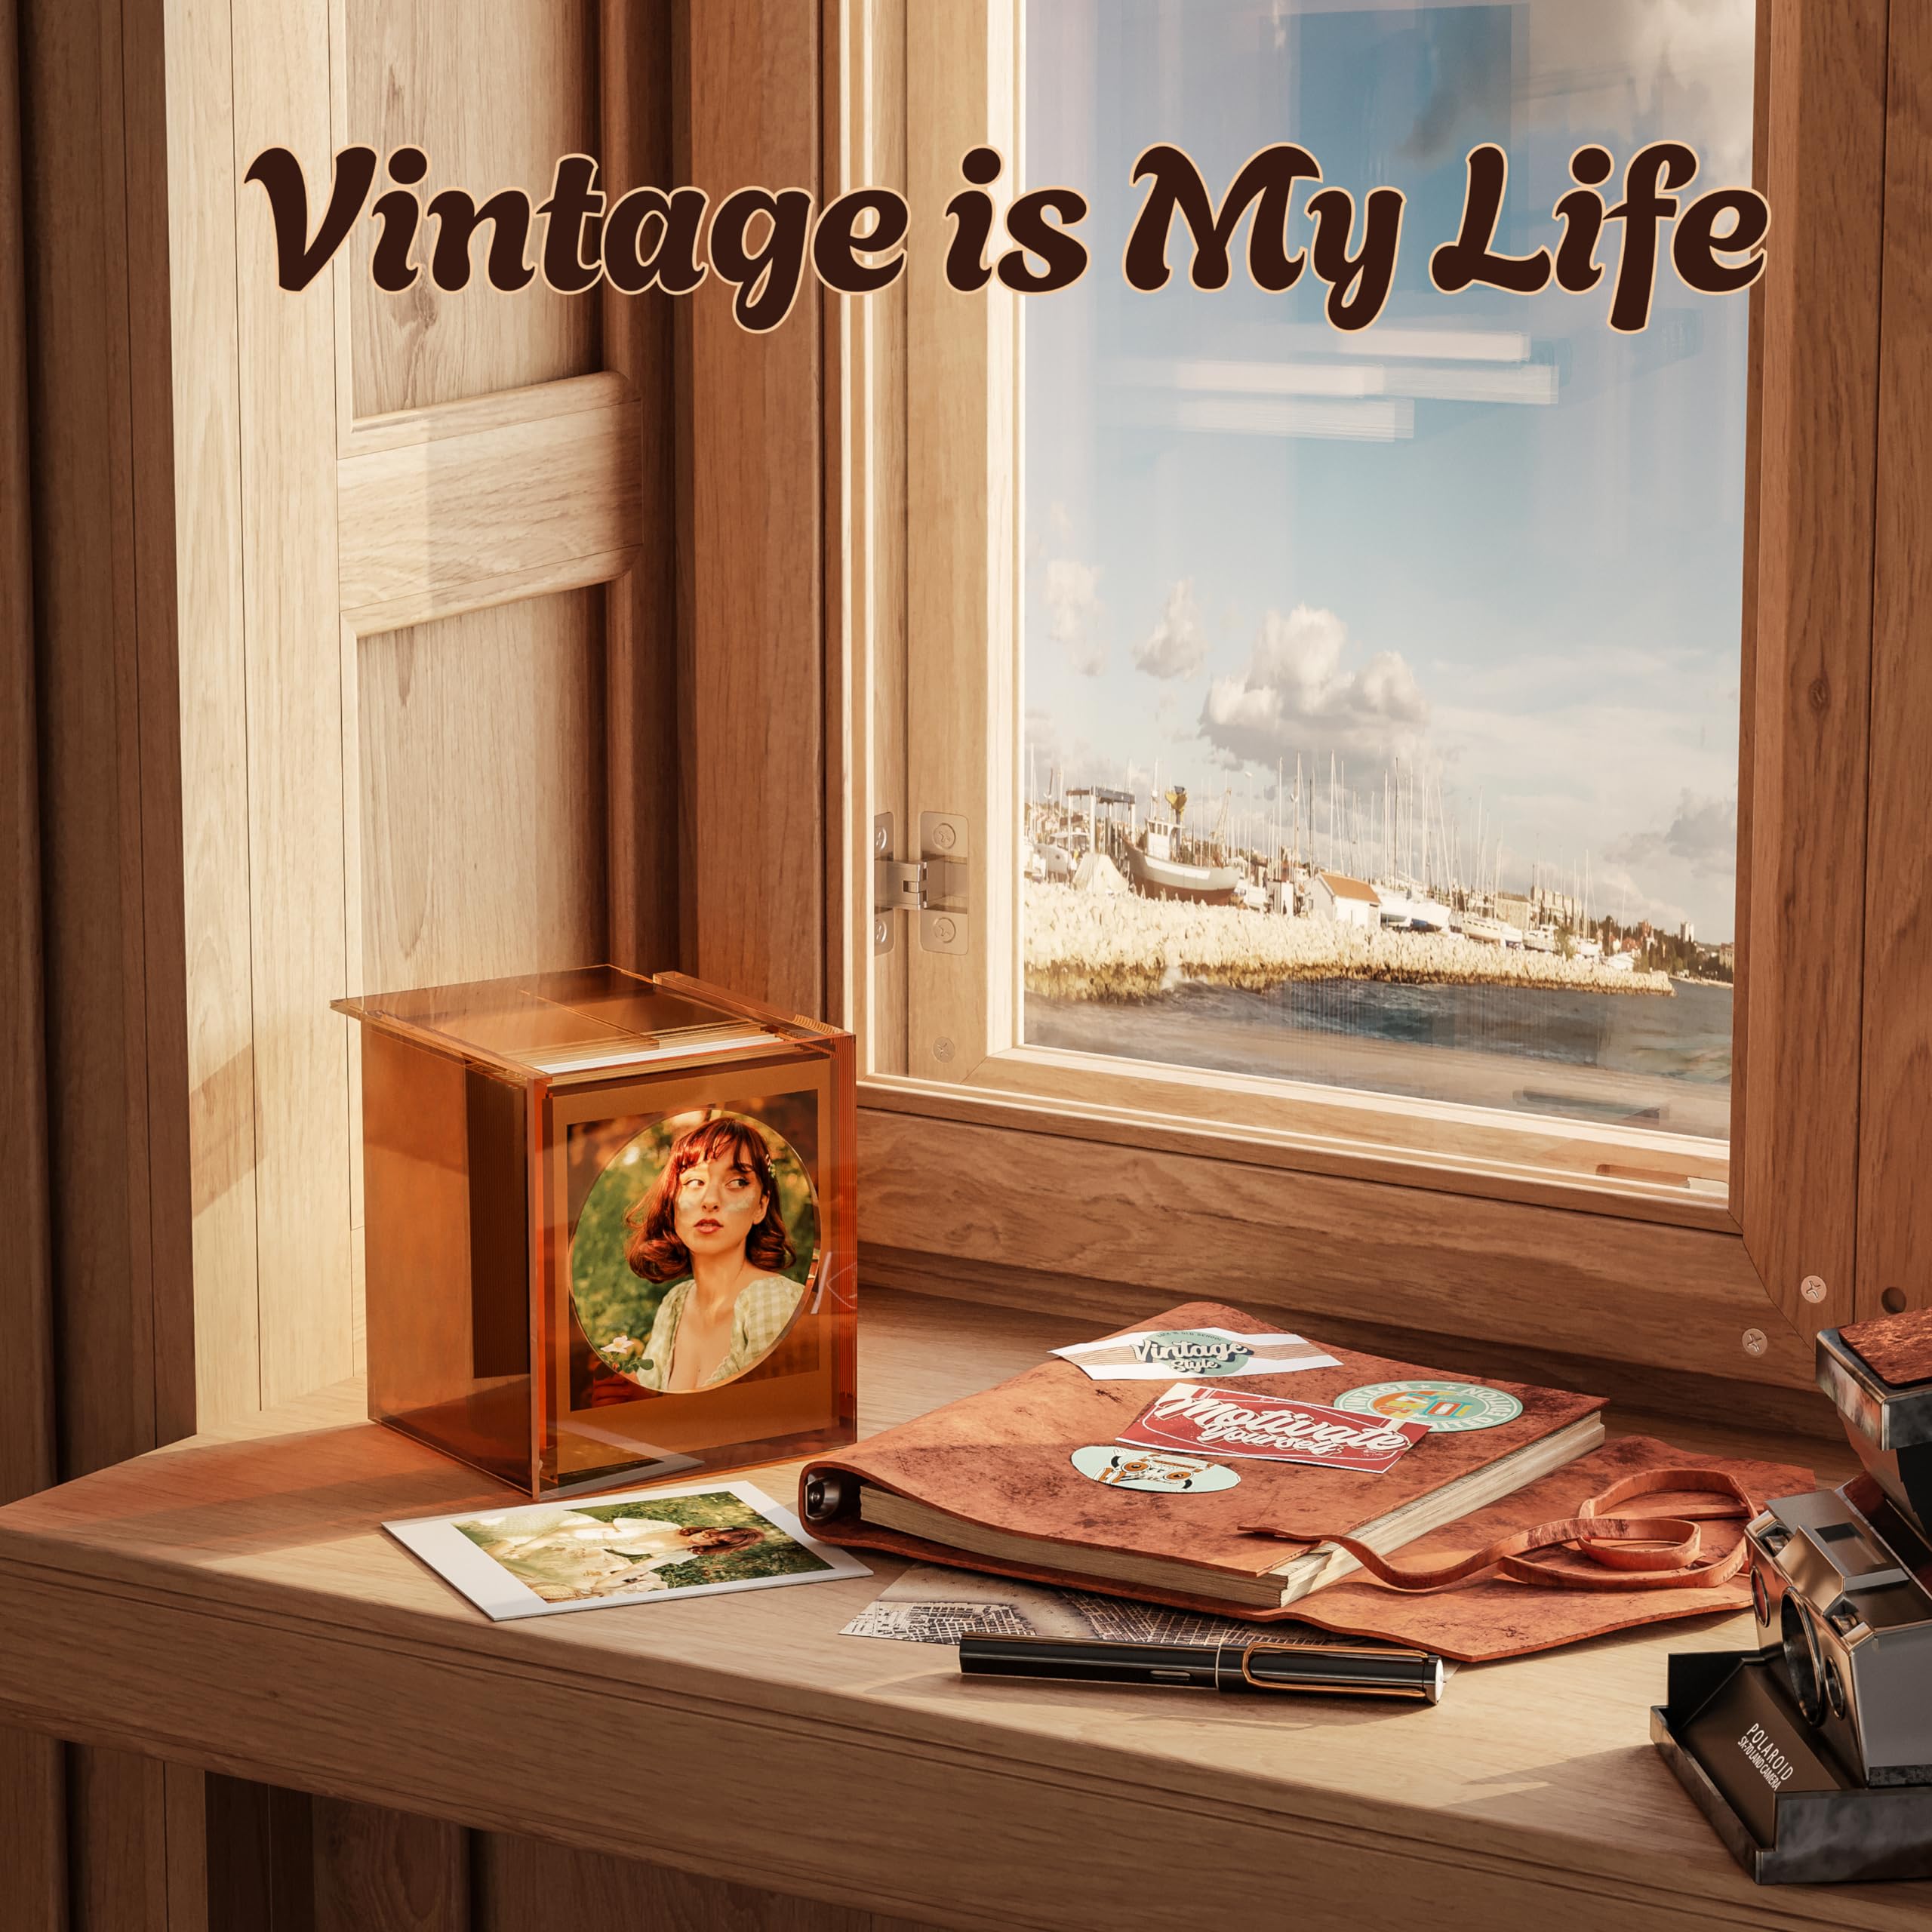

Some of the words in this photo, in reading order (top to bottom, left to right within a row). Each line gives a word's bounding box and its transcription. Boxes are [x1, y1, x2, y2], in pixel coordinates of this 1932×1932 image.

[1129, 1339, 1250, 1361] Vintage
[1171, 1359, 1220, 1372] Style
[1460, 1387, 1512, 1417] EDITION
[1155, 1398, 1410, 1451] Motivate
[1432, 1417, 1494, 1429] ITED
[1199, 1423, 1342, 1456] Yourself
[1737, 1736, 1755, 1755] SX-70
[1749, 1749, 1765, 1769] LAND
[1759, 1764, 1782, 1792] CAMERA
[1746, 1722, 1794, 1781] POLAROID
